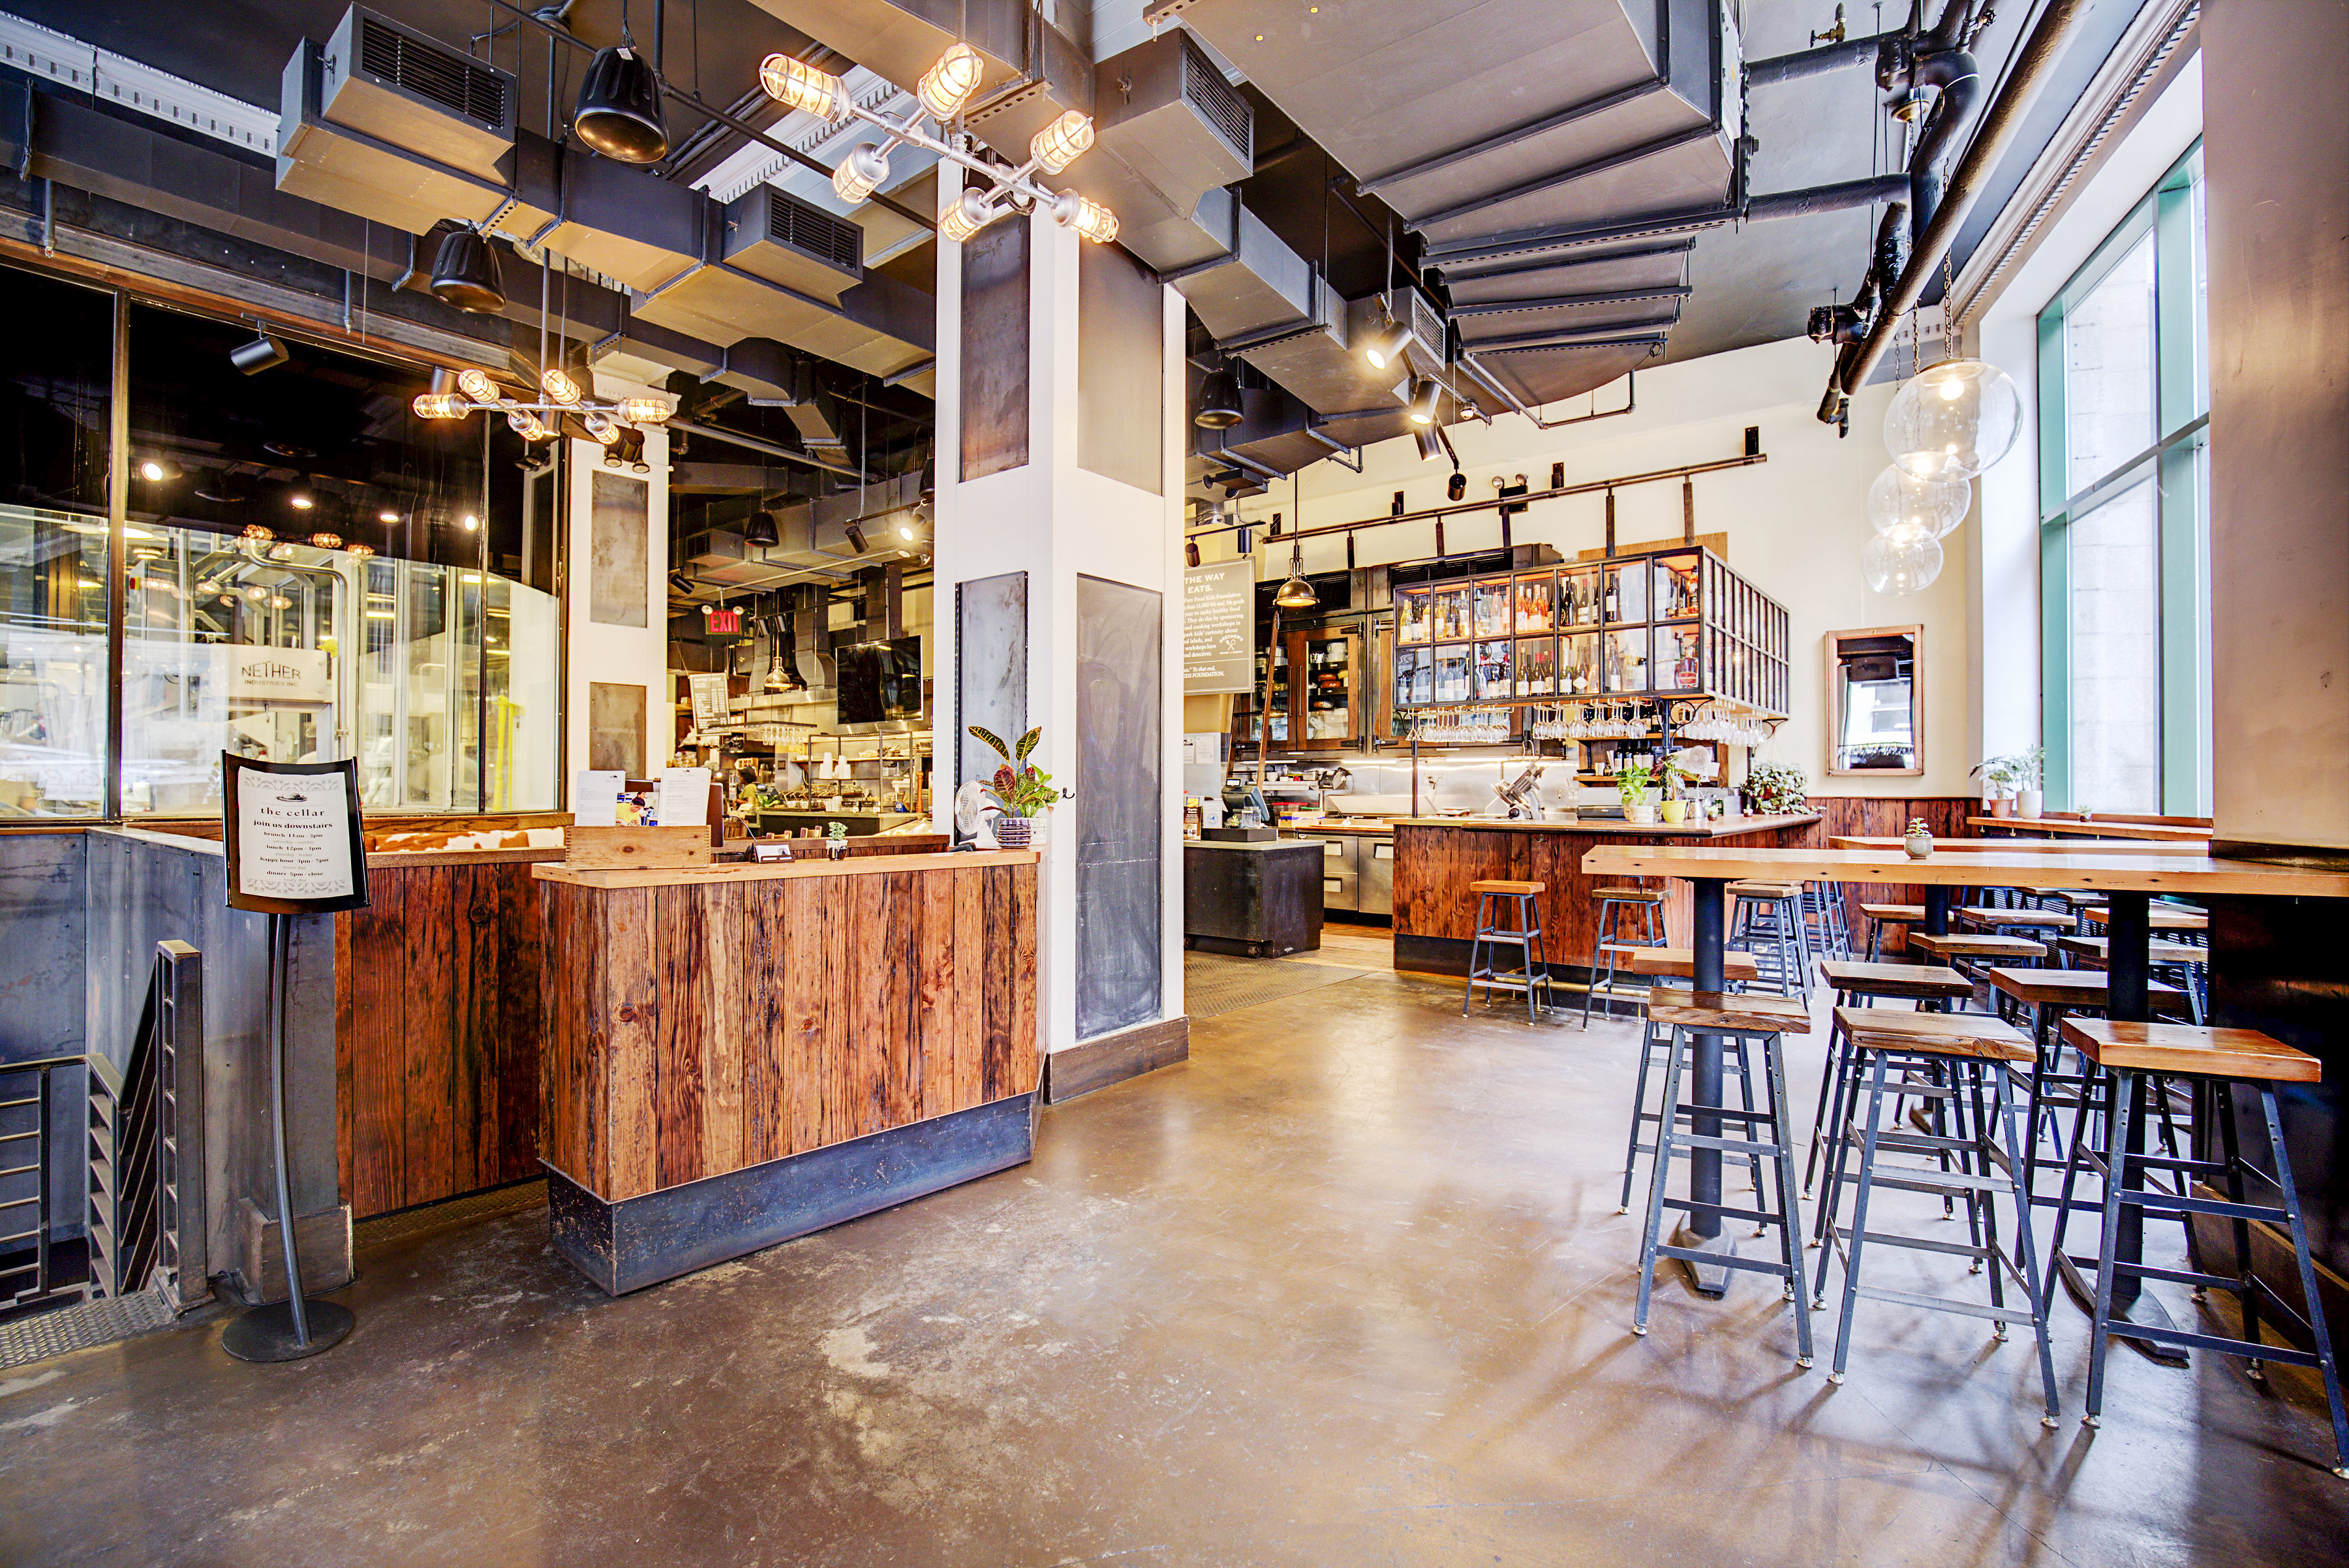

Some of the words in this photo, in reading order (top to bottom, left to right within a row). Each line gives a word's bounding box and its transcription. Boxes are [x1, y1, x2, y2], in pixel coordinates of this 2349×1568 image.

[1184, 576, 1202, 584] THE
[1205, 572, 1225, 581] WAY
[1188, 585, 1212, 593] EATS.
[710, 612, 739, 632] EXIT
[1220, 634, 1244, 643] BEECHER'S
[242, 661, 301, 679] NETHER
